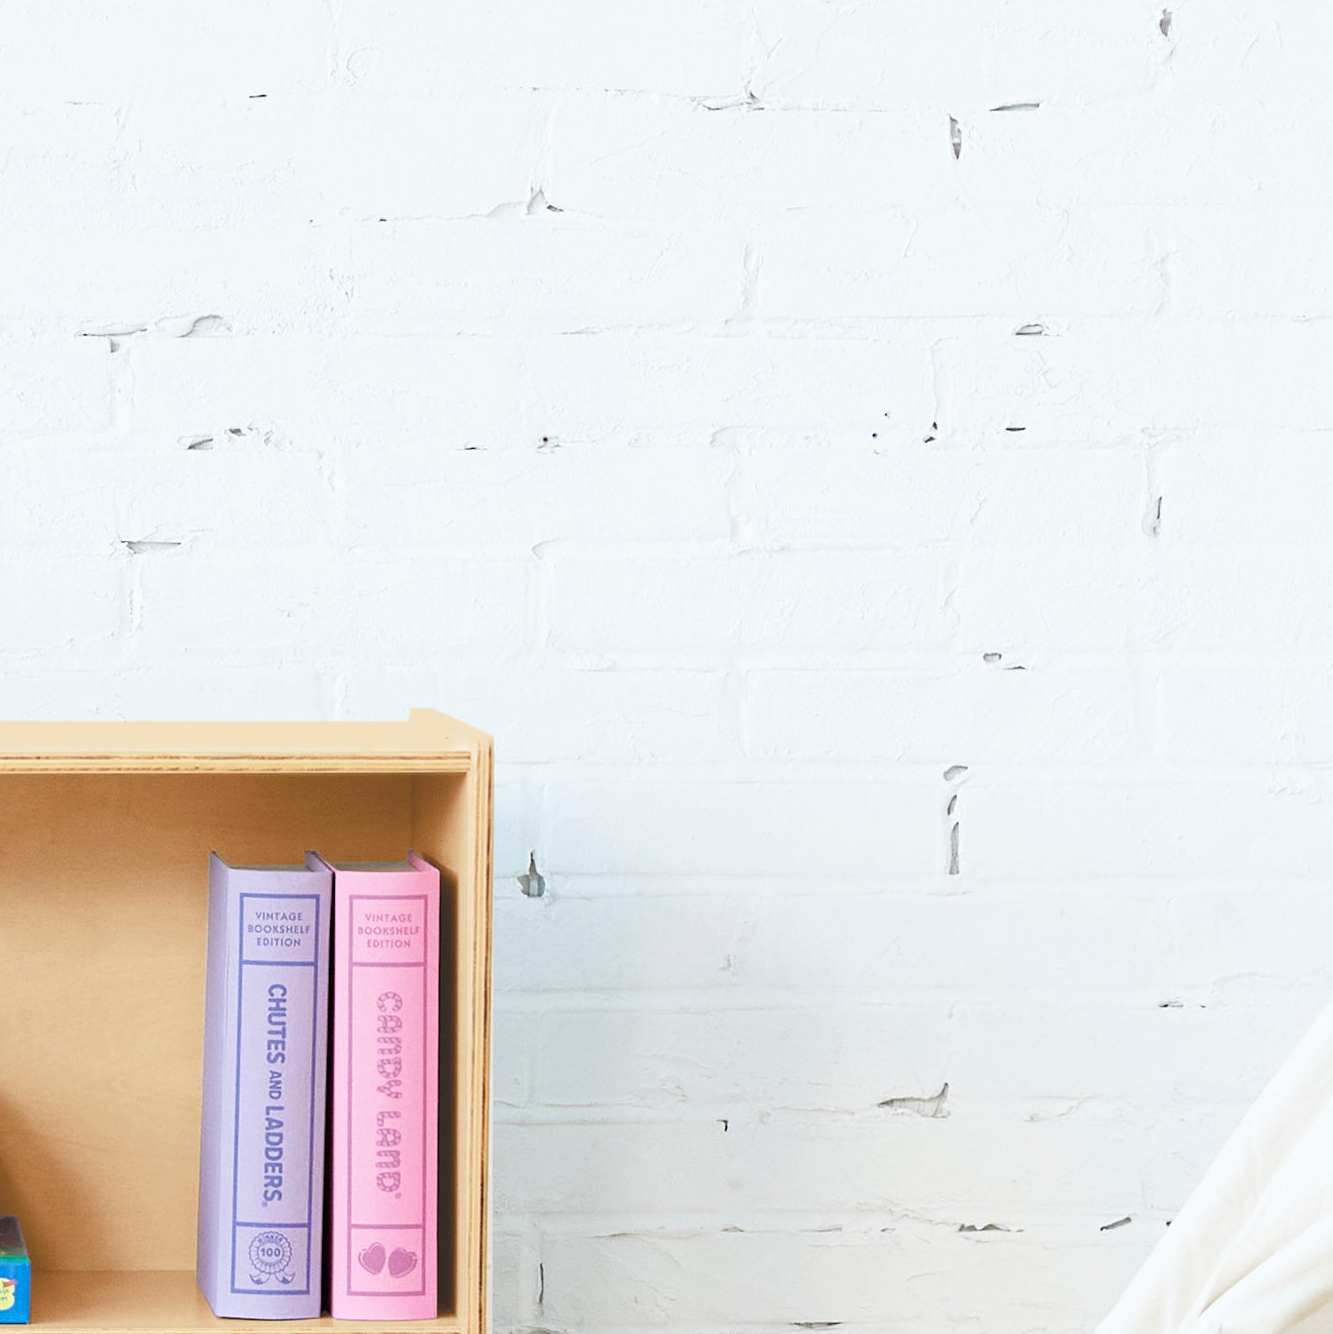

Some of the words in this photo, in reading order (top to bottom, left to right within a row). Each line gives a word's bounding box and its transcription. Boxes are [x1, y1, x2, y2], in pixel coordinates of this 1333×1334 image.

[255, 911, 303, 921] VINTAGE
[365, 913, 413, 923] VINTAGE
[248, 924, 311, 935] BOOKSHELF
[357, 926, 420, 936] BOOKSHELF
[256, 937, 301, 947] EDITION
[367, 939, 411, 948] EDITION
[266, 983, 287, 1064] CHUTES
[376, 991, 403, 1099] CANDY
[269, 1069, 282, 1099] AND
[260, 1247, 281, 1257] 100
